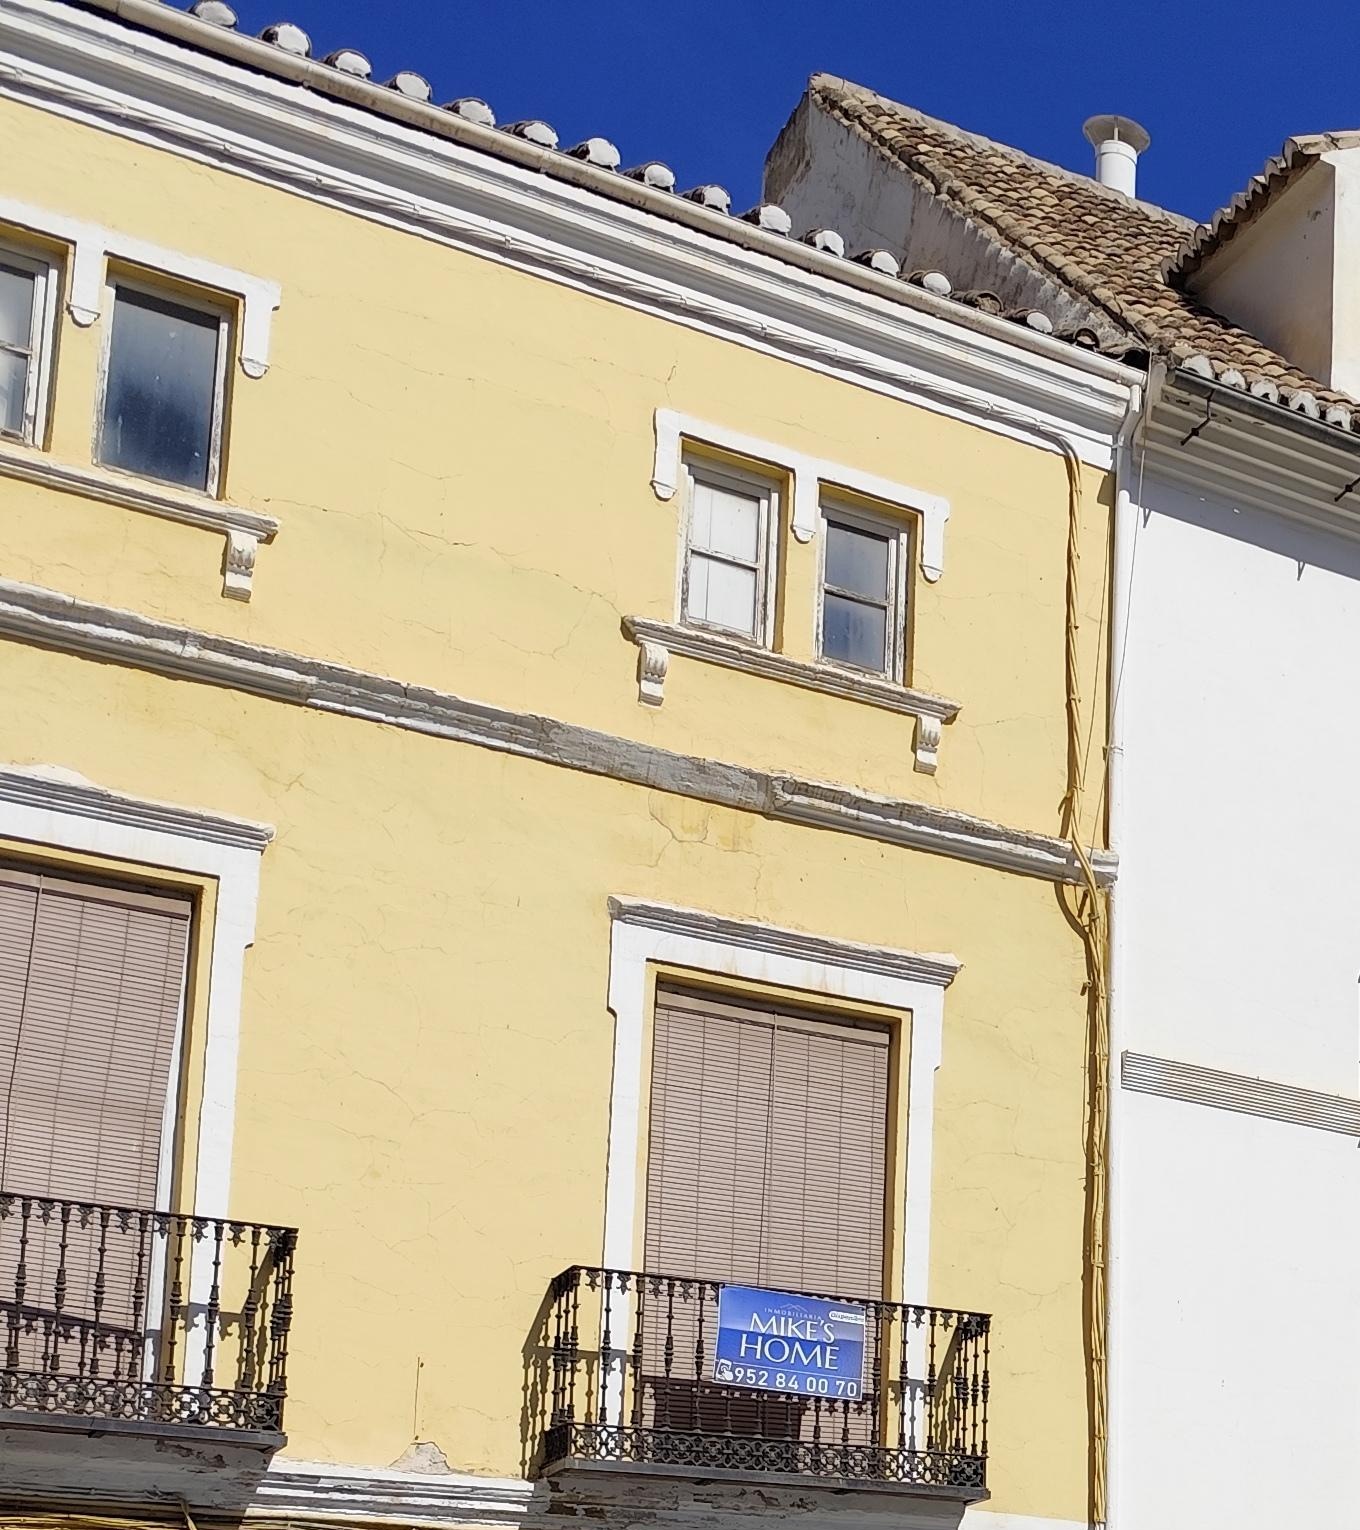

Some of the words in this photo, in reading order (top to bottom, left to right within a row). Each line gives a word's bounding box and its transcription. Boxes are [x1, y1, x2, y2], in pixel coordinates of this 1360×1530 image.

[750, 1313, 835, 1344] MIKE'S
[764, 1307, 822, 1321] INMOBILIARIA
[740, 1333, 840, 1370] HOME
[734, 1367, 769, 1386] 952
[775, 1373, 799, 1391] 84
[806, 1376, 829, 1394] 00
[835, 1380, 857, 1397] 70
